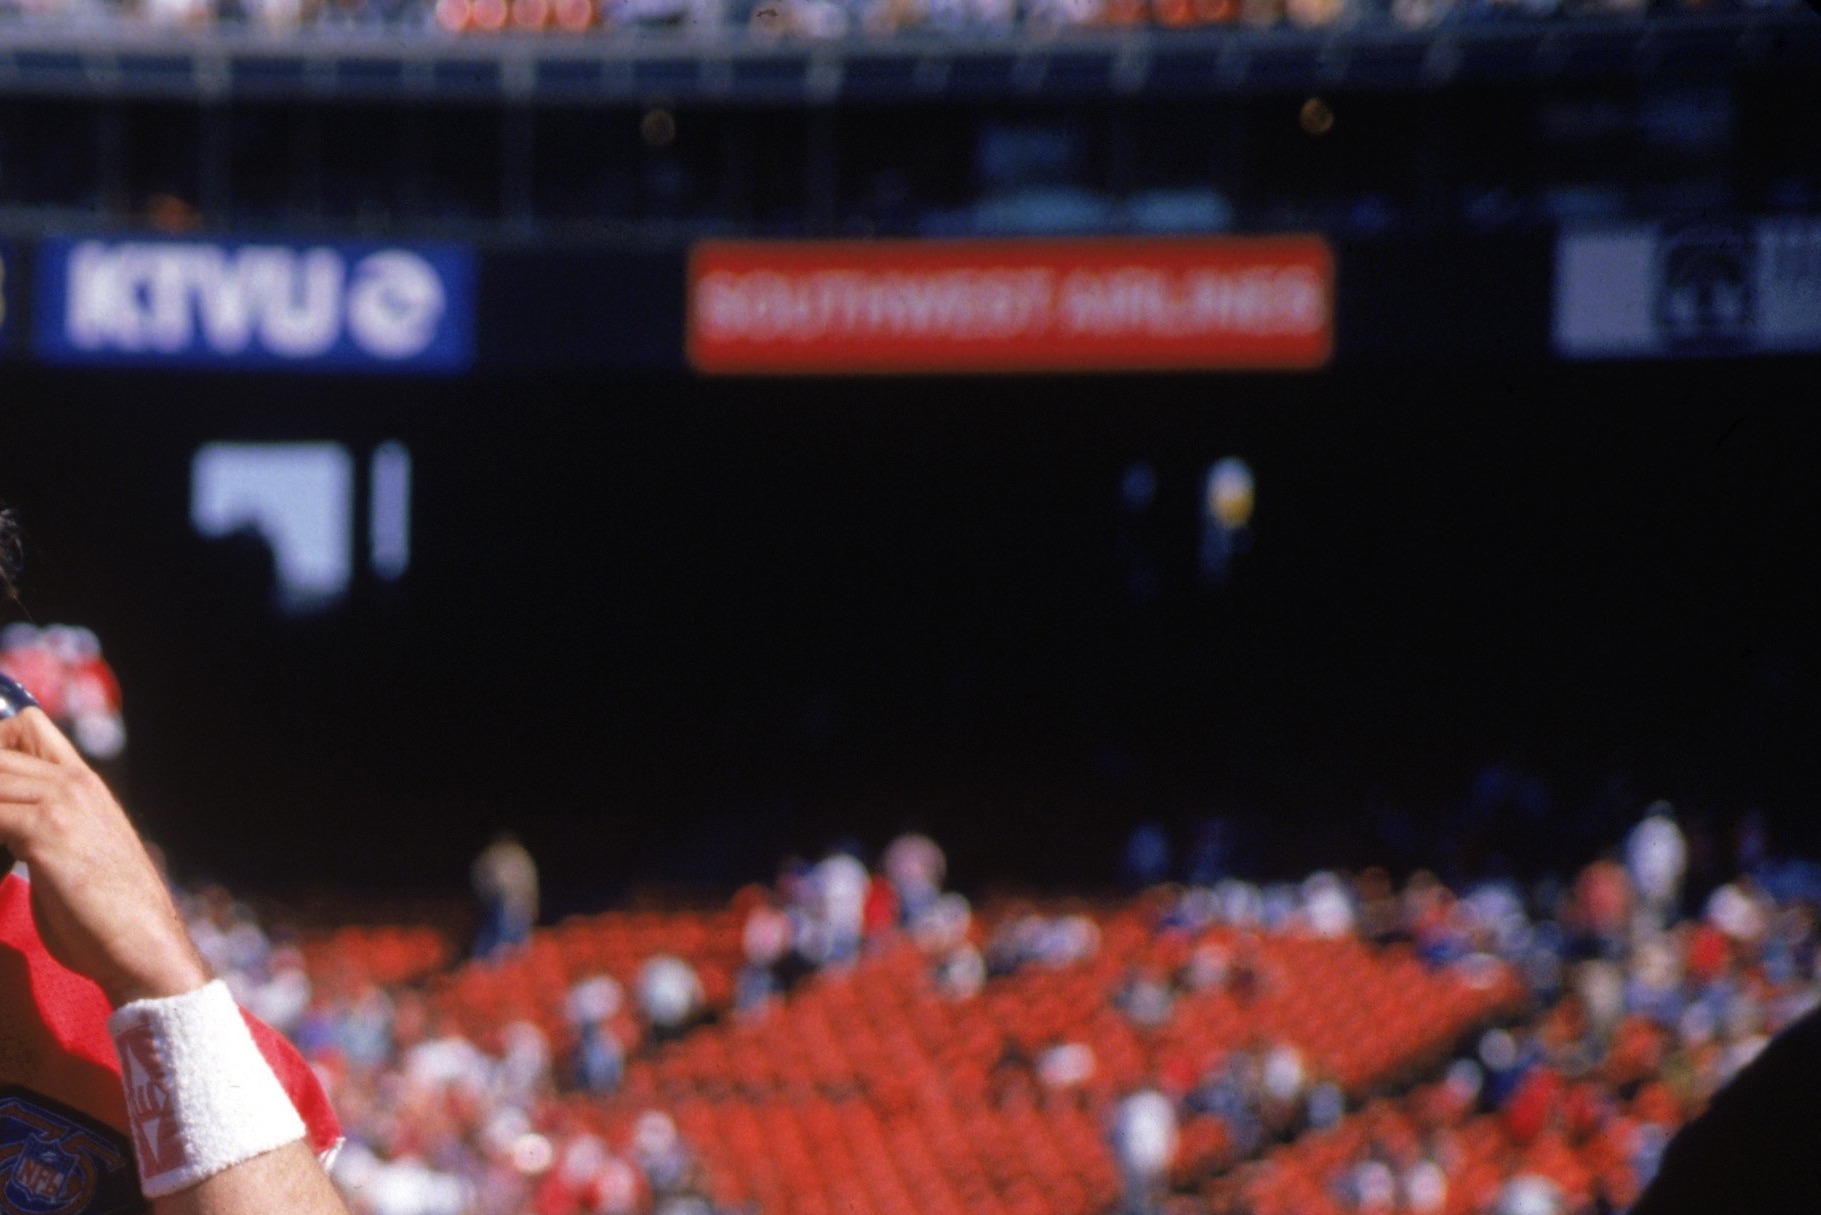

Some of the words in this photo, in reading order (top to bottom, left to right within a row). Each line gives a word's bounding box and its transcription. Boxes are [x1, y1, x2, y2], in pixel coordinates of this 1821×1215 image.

[64, 240, 344, 357] KTVU
[697, 268, 1053, 340] SOUTHWEST
[1062, 266, 1325, 335] AIRLINES
